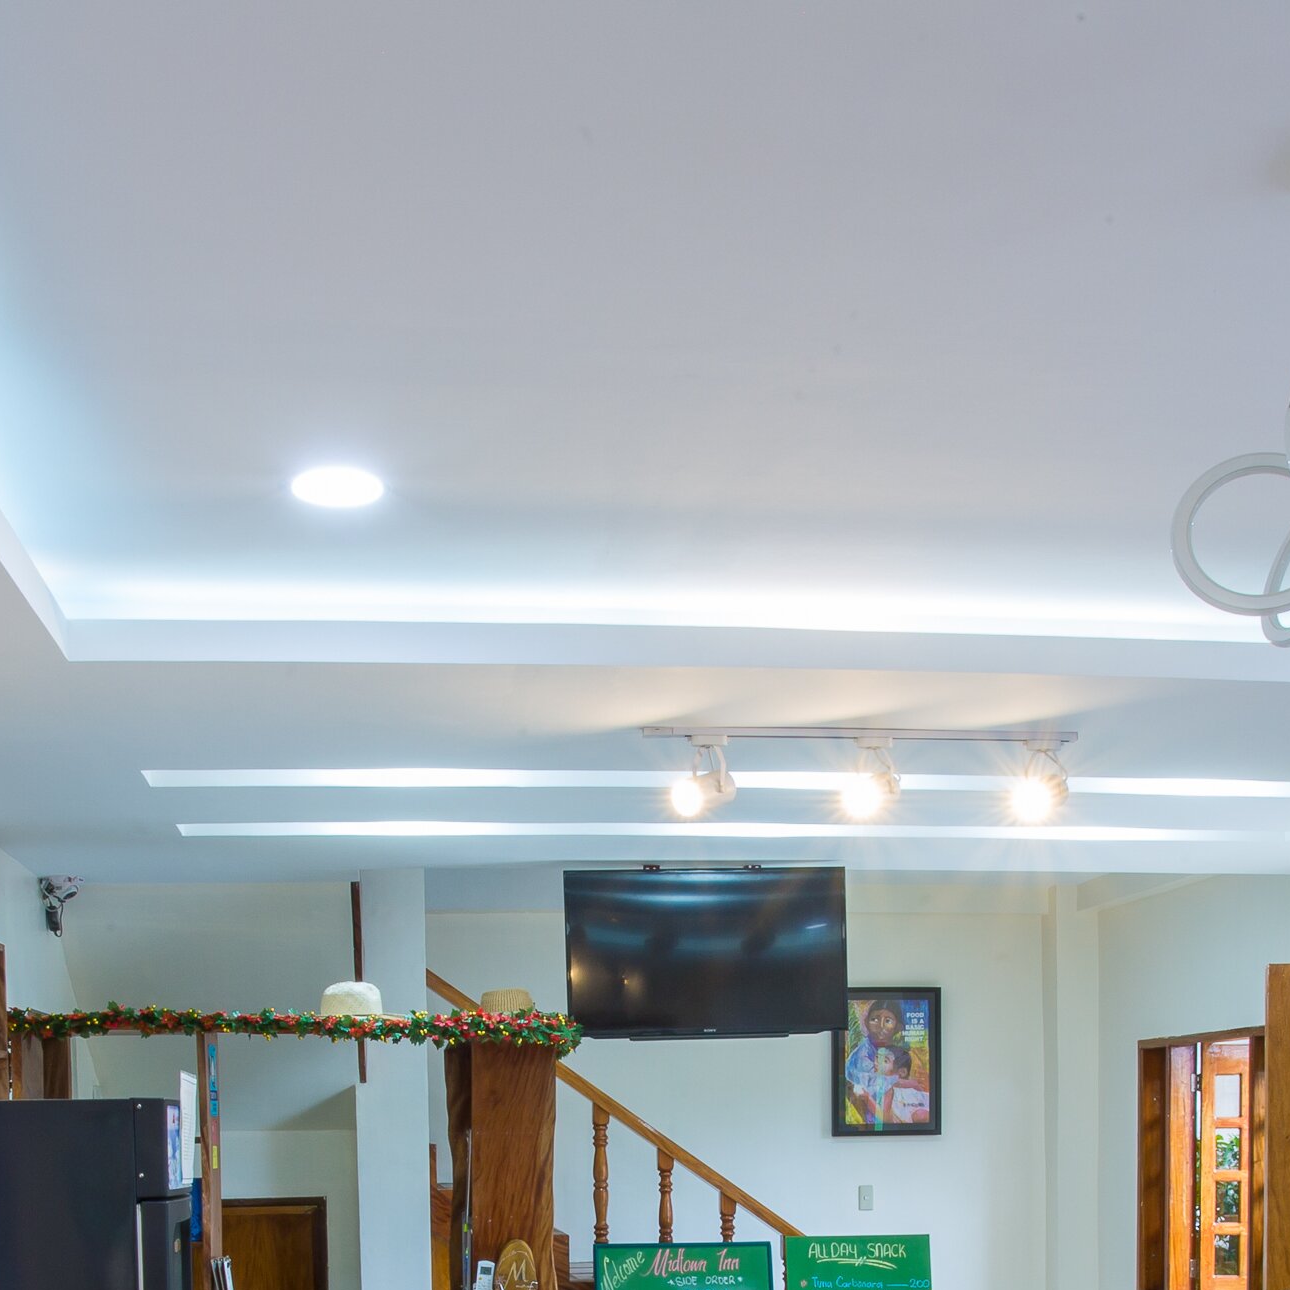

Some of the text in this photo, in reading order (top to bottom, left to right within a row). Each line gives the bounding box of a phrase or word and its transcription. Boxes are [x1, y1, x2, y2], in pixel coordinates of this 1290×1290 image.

[808, 1242, 906, 1258] ALL DAY SNACK
[641, 1248, 707, 1277] Midtown
[717, 1248, 740, 1271] Inn
[675, 1275, 736, 1286] SIDE ORDER
[811, 1276, 930, 1289] Tuna Carbonara 200
